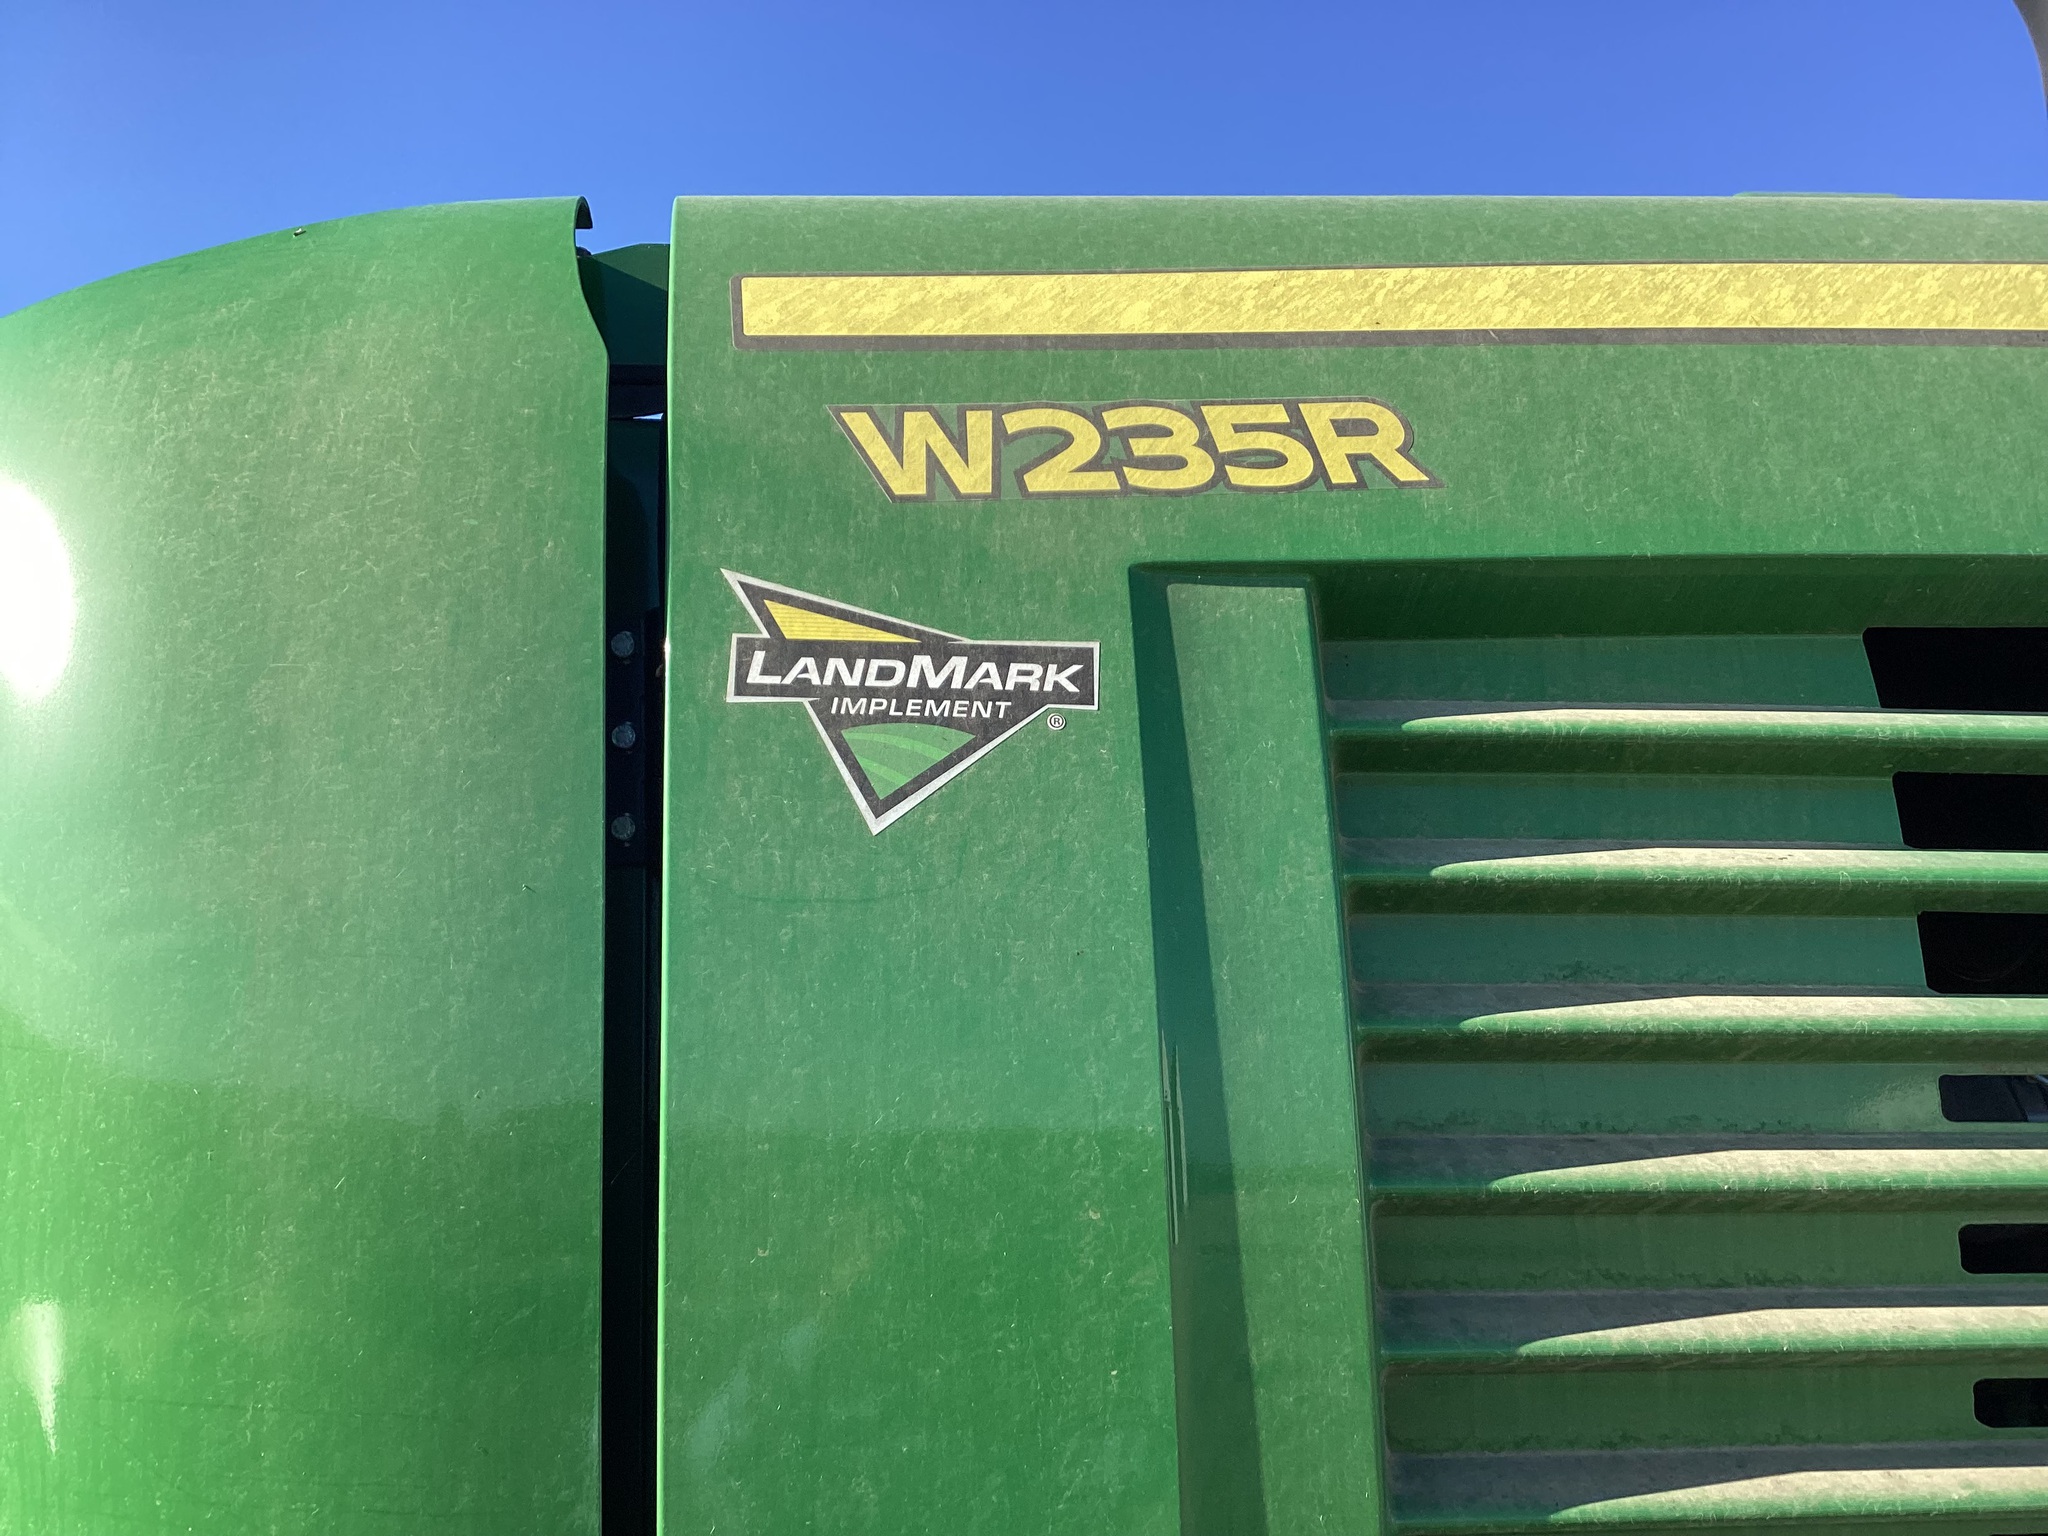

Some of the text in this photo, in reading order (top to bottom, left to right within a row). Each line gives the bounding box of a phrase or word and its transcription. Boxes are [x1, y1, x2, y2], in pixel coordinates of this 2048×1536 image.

[839, 401, 1431, 496] W235R
[746, 650, 1084, 692] LANDMARK
[831, 697, 1011, 718] IMPLEMENT
